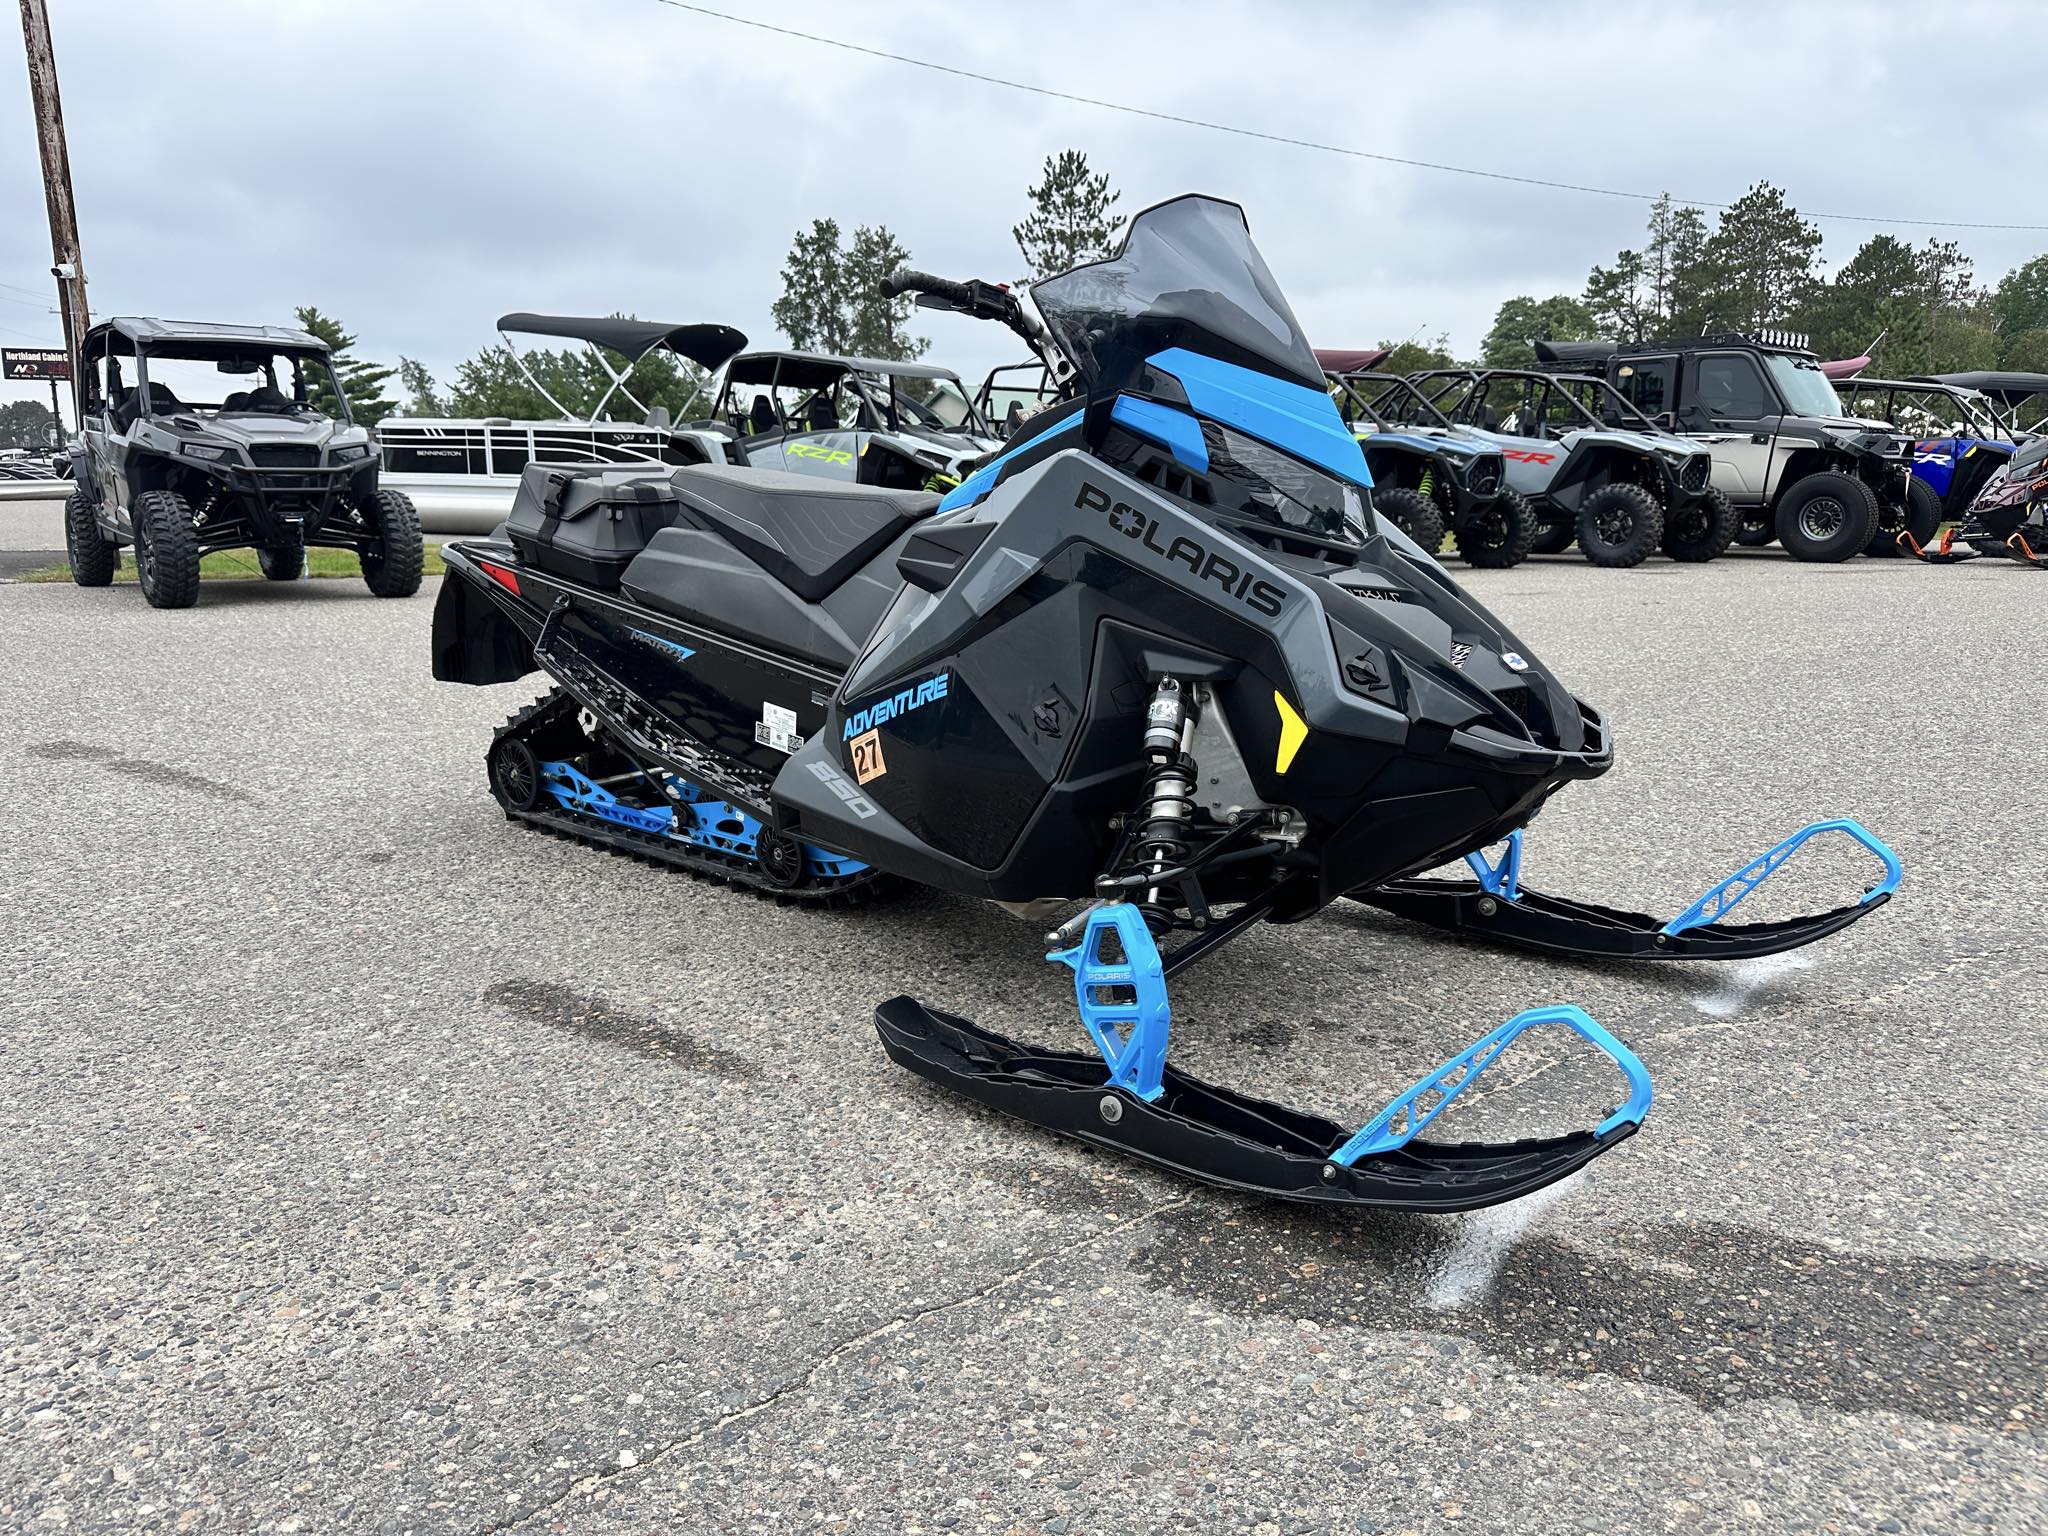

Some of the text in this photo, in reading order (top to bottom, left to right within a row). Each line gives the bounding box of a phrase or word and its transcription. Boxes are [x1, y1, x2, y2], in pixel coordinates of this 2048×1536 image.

[6, 352, 41, 361] Northland
[42, 353, 63, 361] Cabin
[786, 443, 853, 465] RZR
[1074, 482, 1288, 618] POLARIS
[843, 673, 949, 741] ADVENTURE
[854, 738, 878, 776] 27
[805, 760, 878, 819] 850
[1088, 972, 1131, 980] POLARIS
[1348, 1111, 1390, 1152] POLARIS
